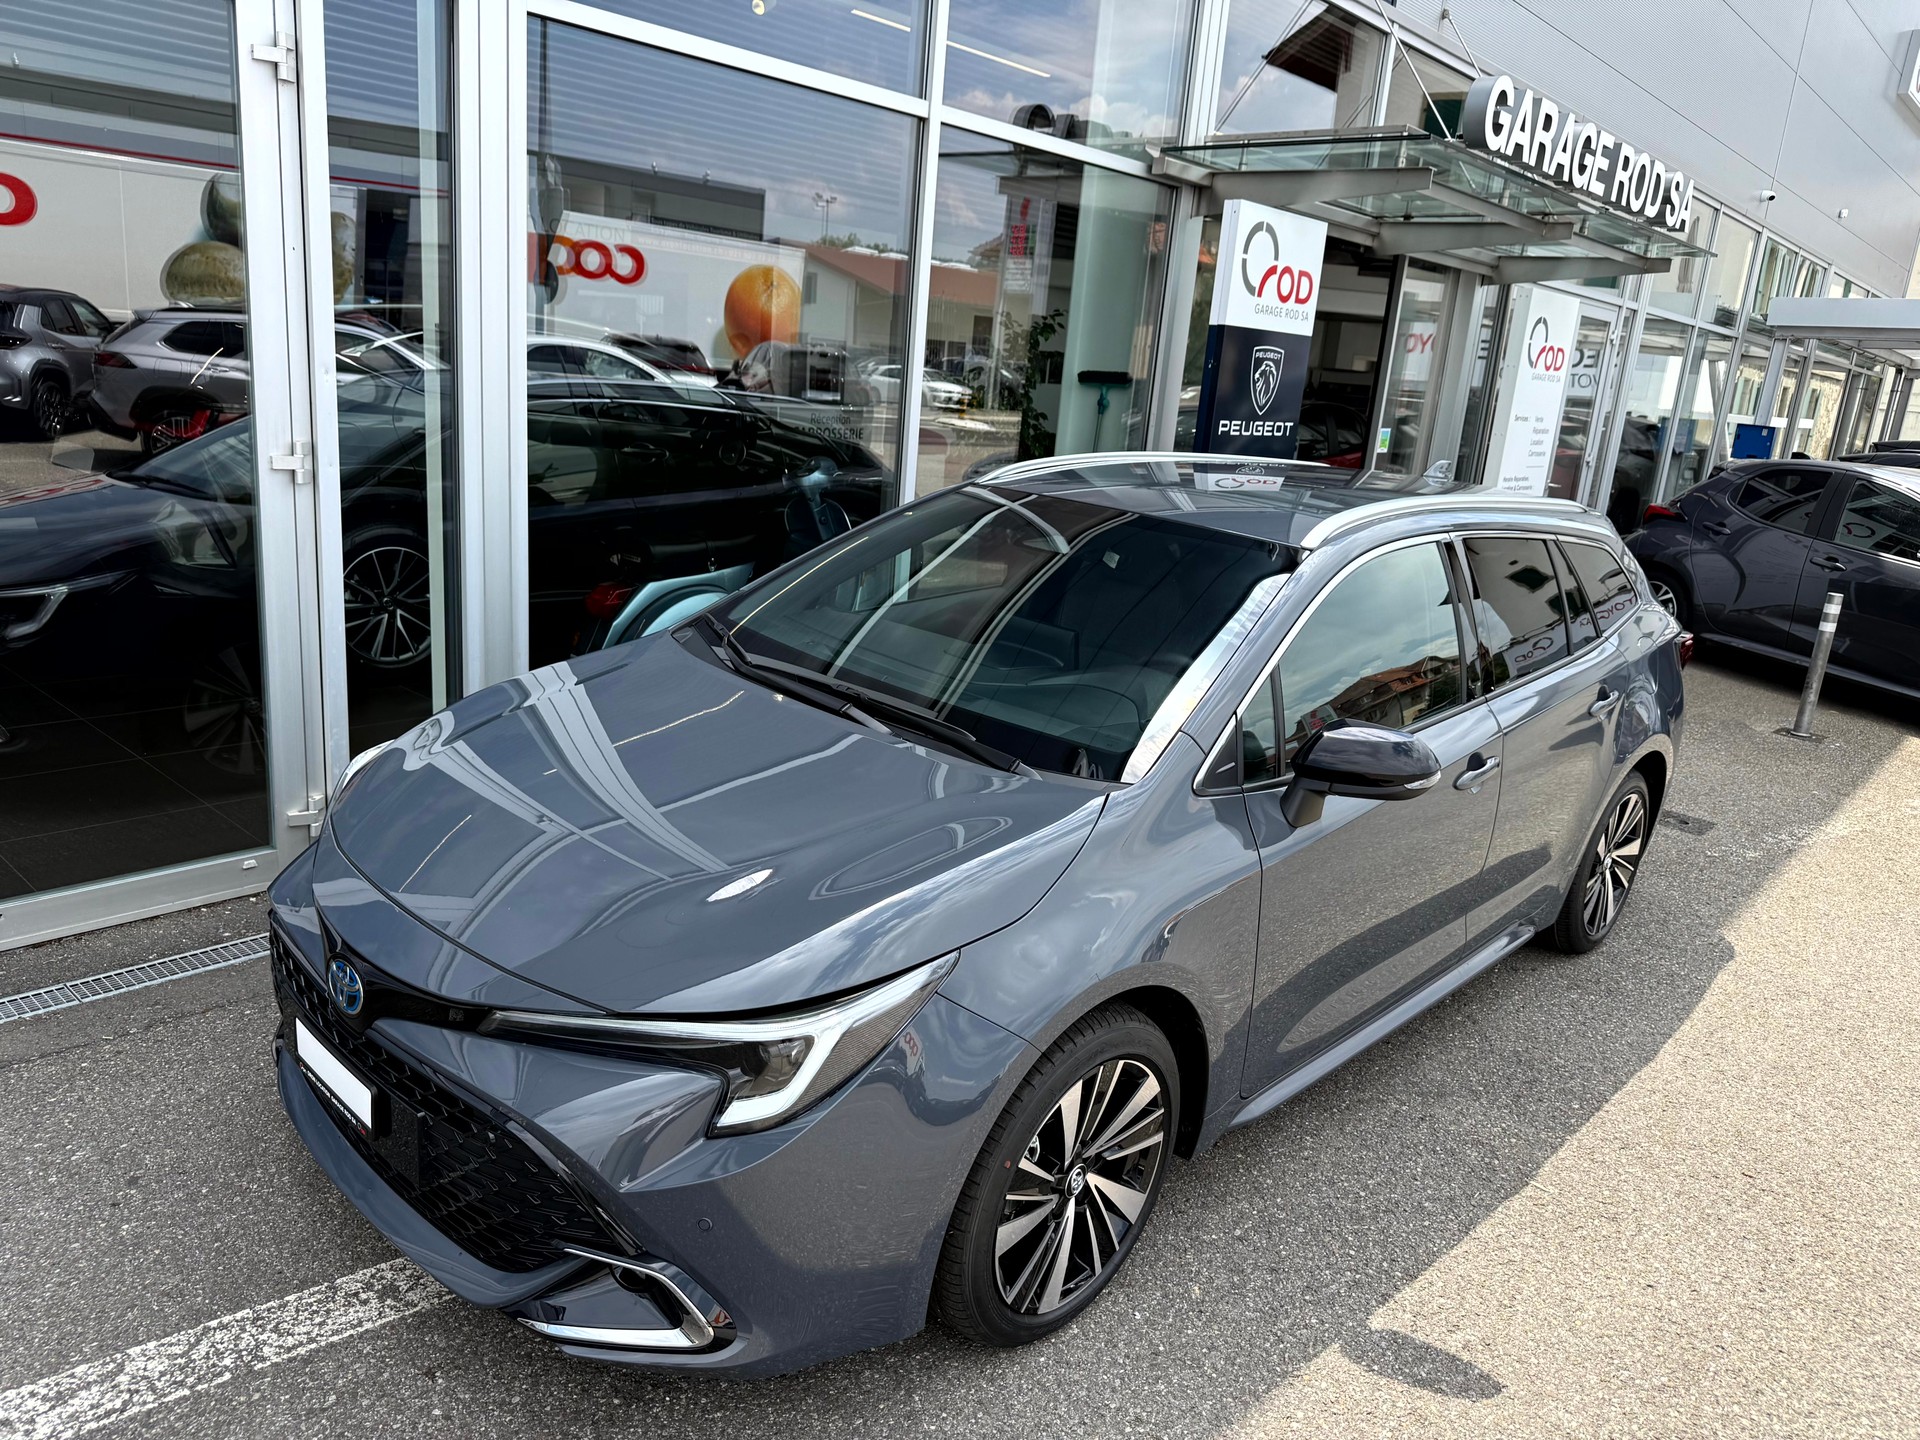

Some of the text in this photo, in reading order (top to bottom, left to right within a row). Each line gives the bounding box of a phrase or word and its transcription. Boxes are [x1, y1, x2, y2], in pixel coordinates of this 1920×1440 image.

[1484, 75, 1695, 233] GARAGE ROD SA
[1254, 303, 1309, 322] GARAGE ROD SA
[1255, 351, 1281, 360] PEUGEOT
[810, 412, 851, 427] Réception
[1218, 420, 1294, 437] PEUGEOT
